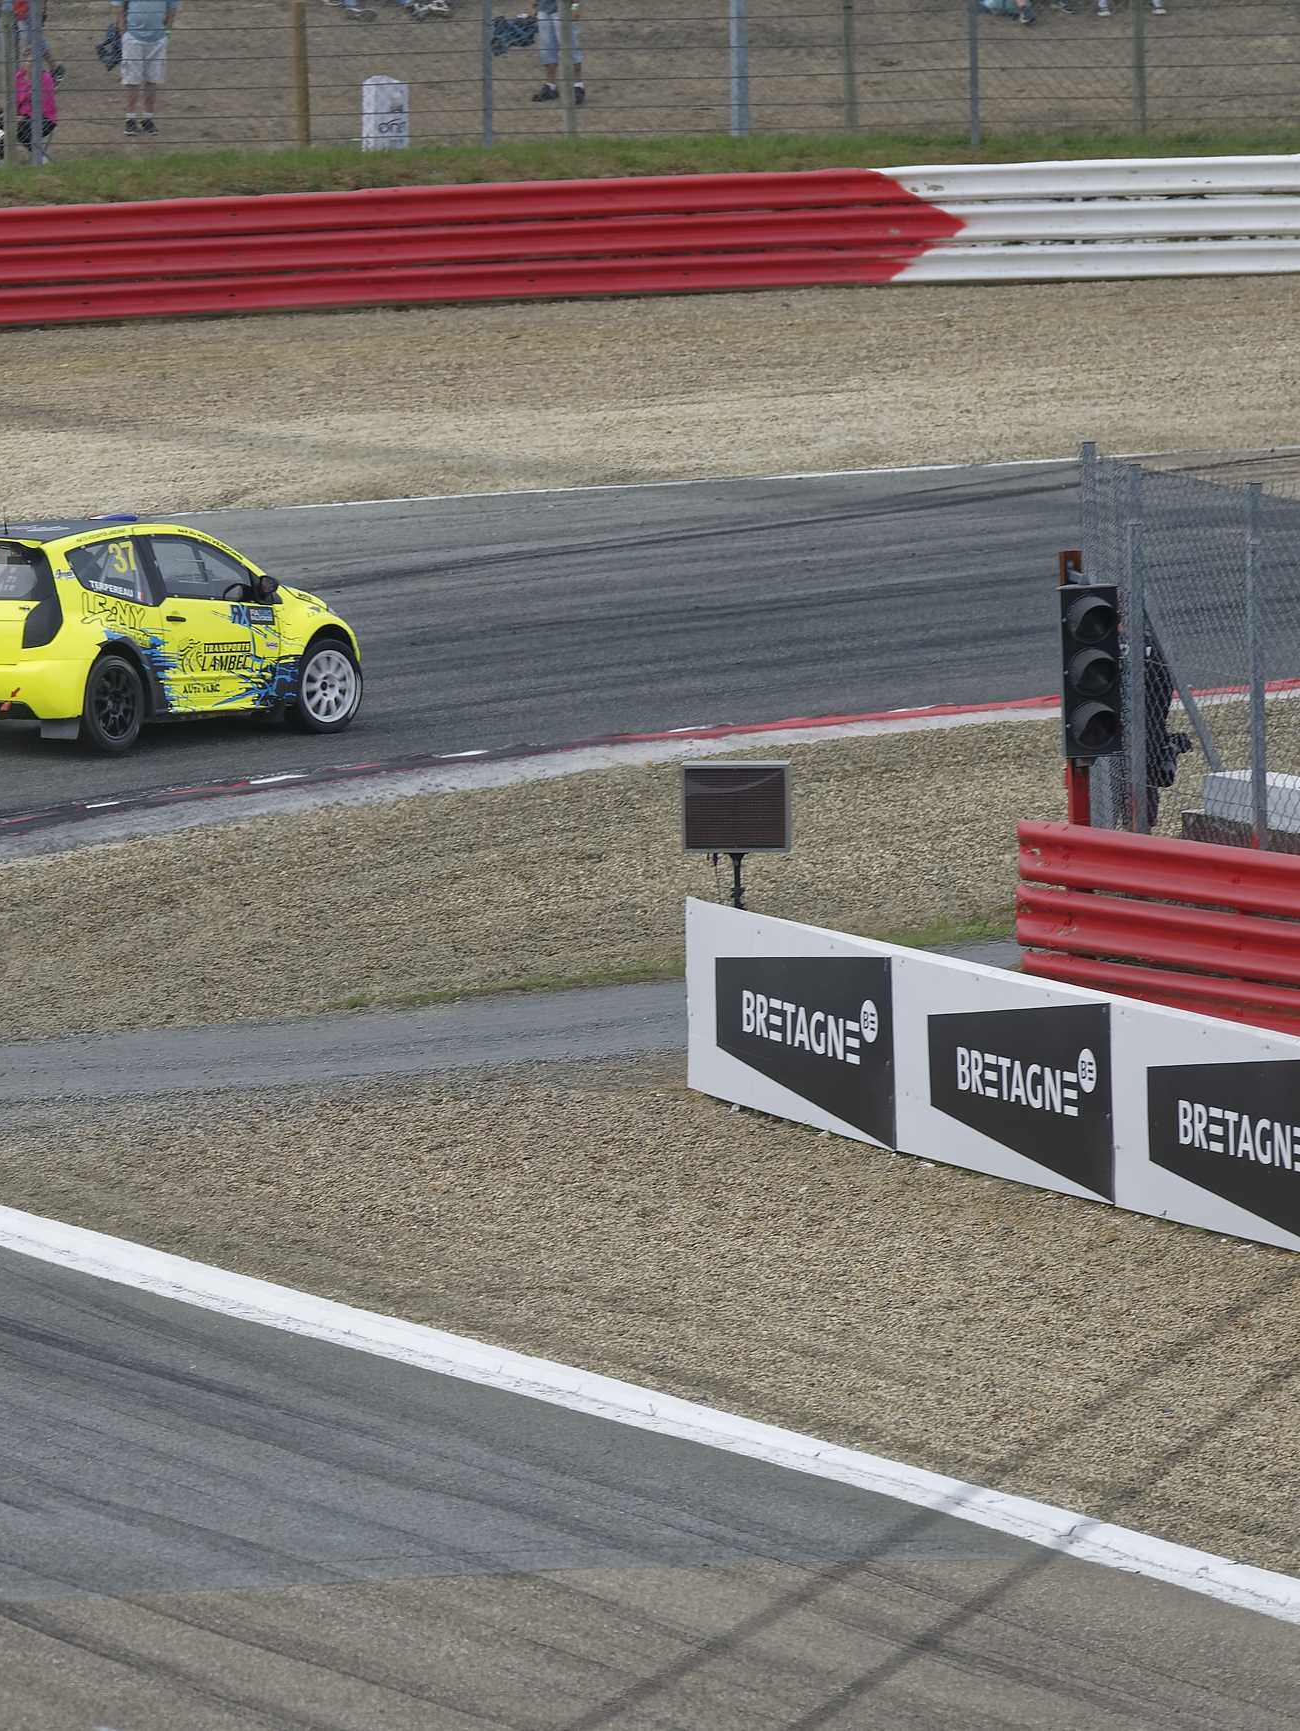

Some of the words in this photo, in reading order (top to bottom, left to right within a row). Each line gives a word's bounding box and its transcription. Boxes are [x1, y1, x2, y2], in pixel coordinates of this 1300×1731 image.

[108, 541, 136, 574] 37
[743, 990, 860, 1064] BRETAGNE
[957, 1047, 1078, 1117] BRETAGNE
